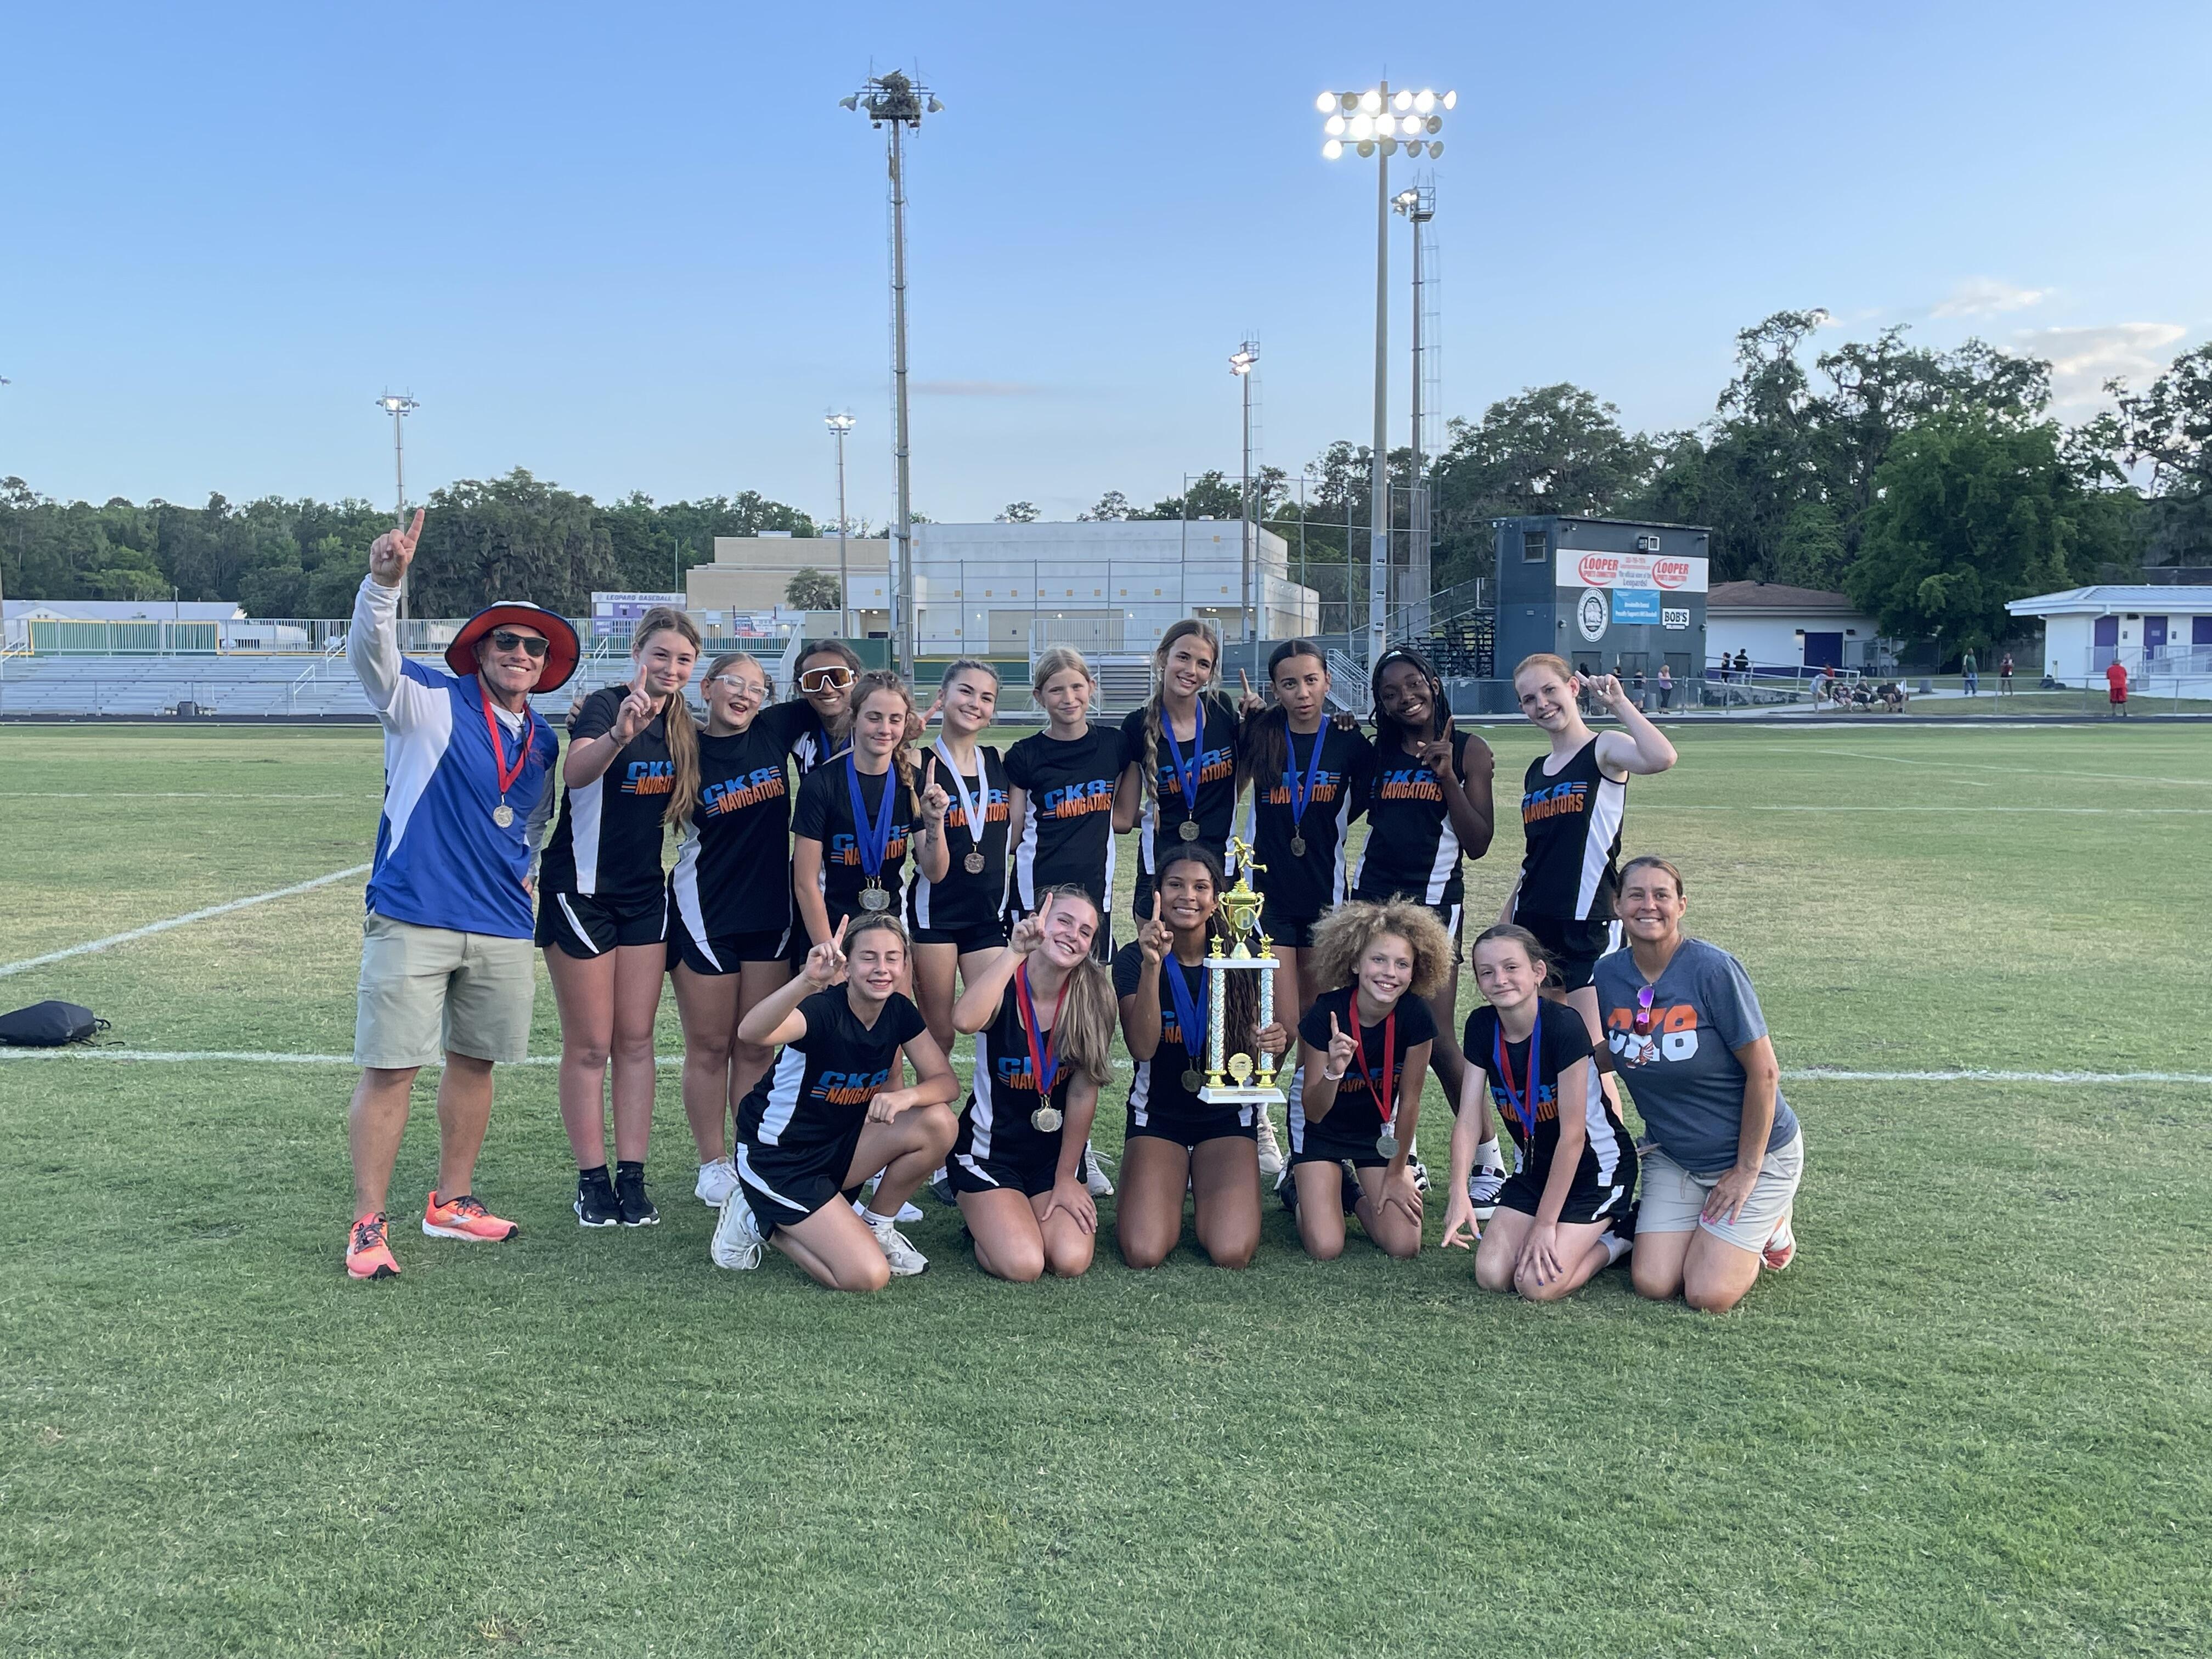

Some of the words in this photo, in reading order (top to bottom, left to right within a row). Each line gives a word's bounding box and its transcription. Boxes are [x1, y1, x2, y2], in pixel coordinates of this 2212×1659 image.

[1584, 557, 1618, 571] LOOPER
[1657, 562, 1689, 574] LOOPER
[1664, 611, 1687, 623] BOB'S
[703, 768, 772, 804] CK8
[718, 777, 785, 814] NAVIGATORS
[1044, 780, 1106, 809] CK8
[1056, 793, 1111, 819] NAVIGATORS
[1524, 793, 1584, 824] NAVIGATORS
